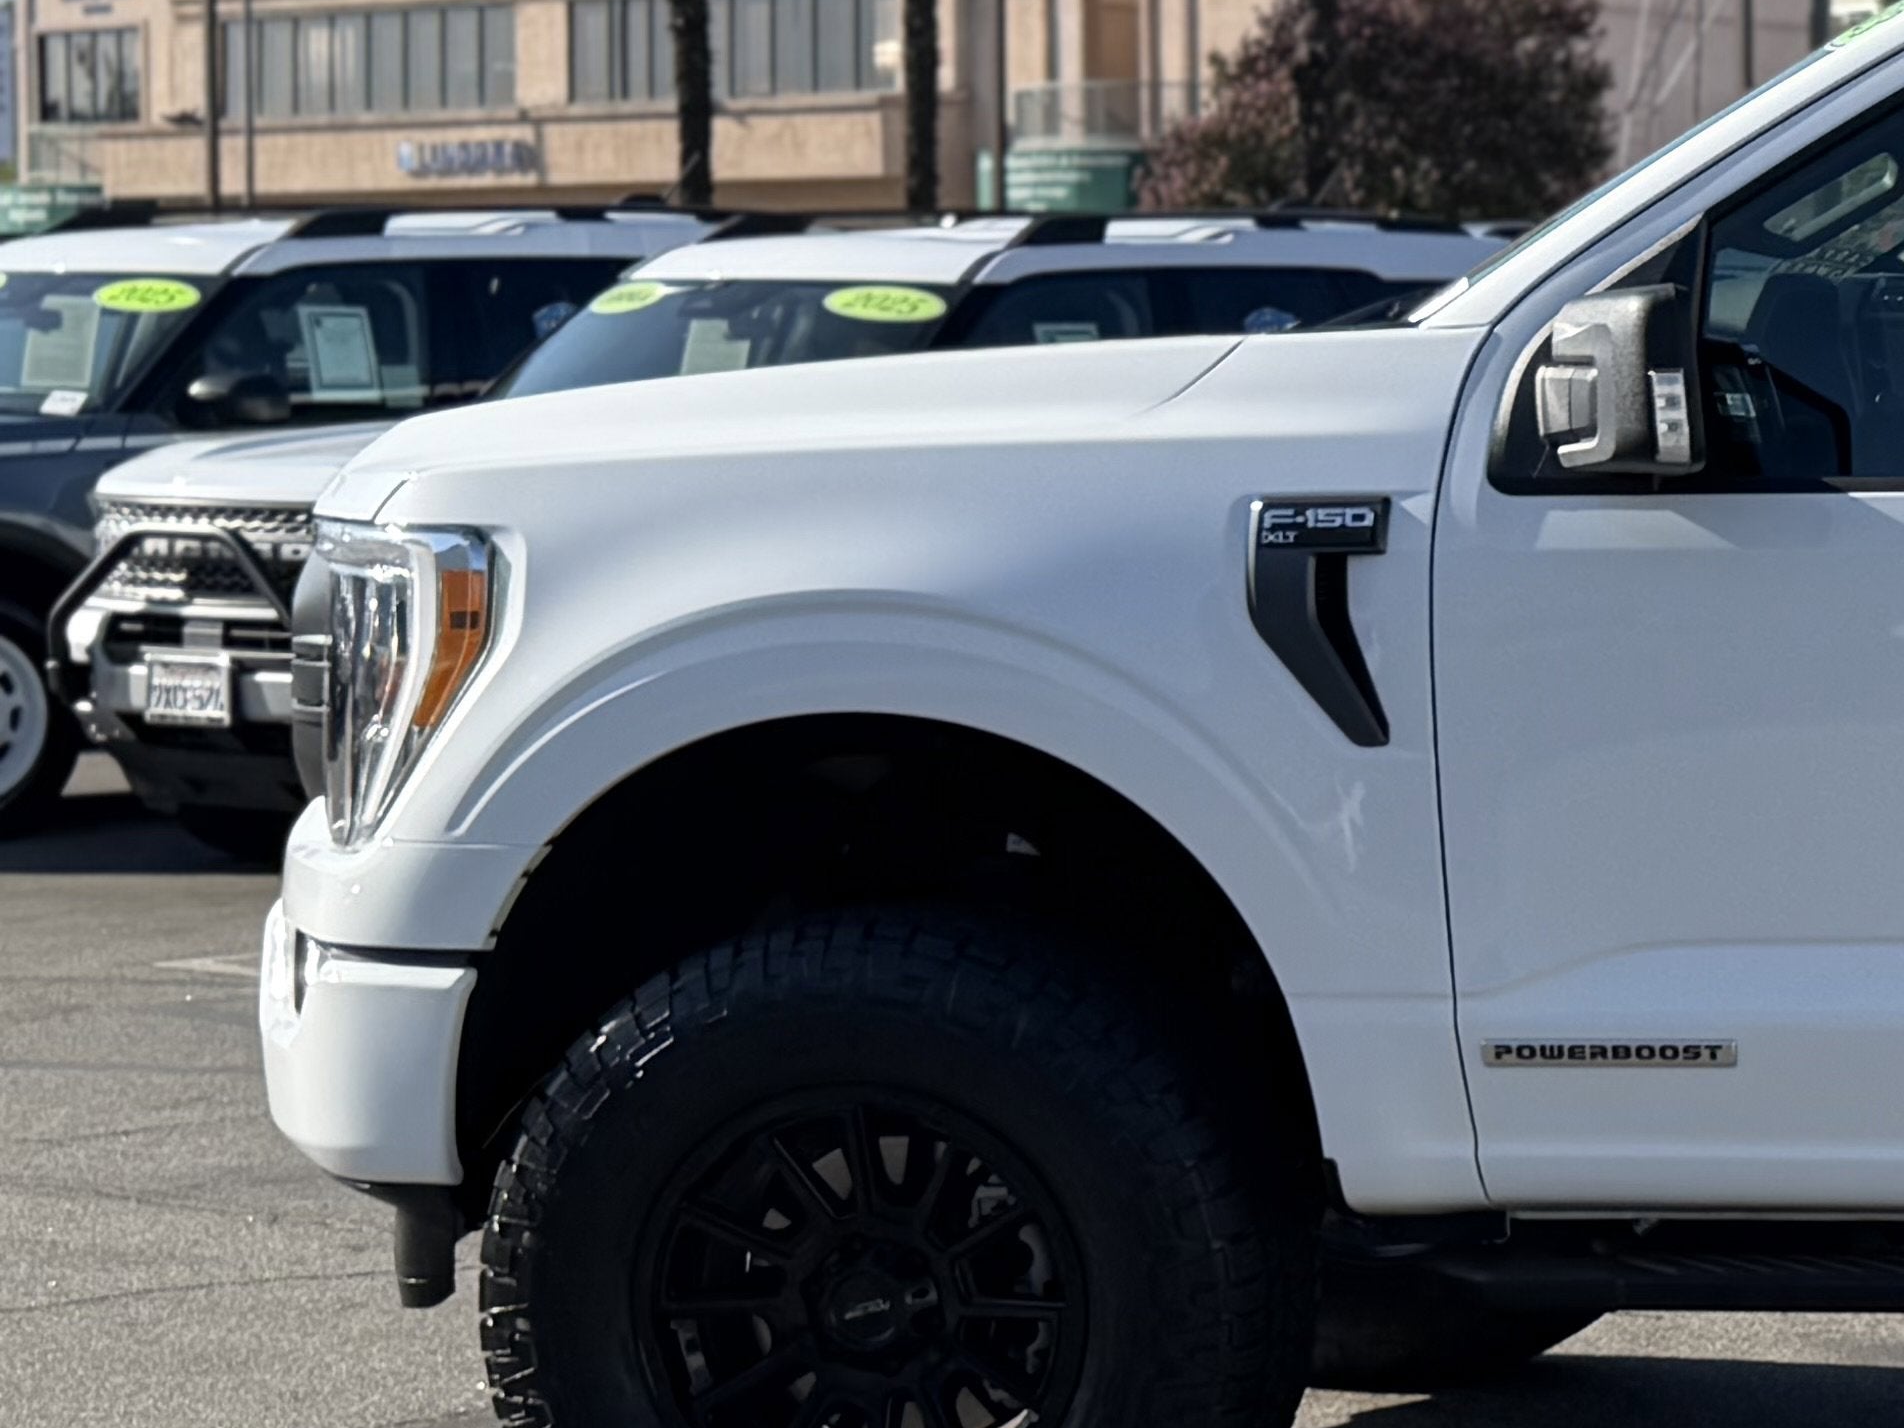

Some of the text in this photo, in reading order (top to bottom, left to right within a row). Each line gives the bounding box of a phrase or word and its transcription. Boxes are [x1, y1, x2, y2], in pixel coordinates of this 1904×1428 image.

[1262, 506, 1375, 528] F-150
[1262, 530, 1298, 544] XLT
[1494, 1044, 1723, 1061] POWERBOOST
